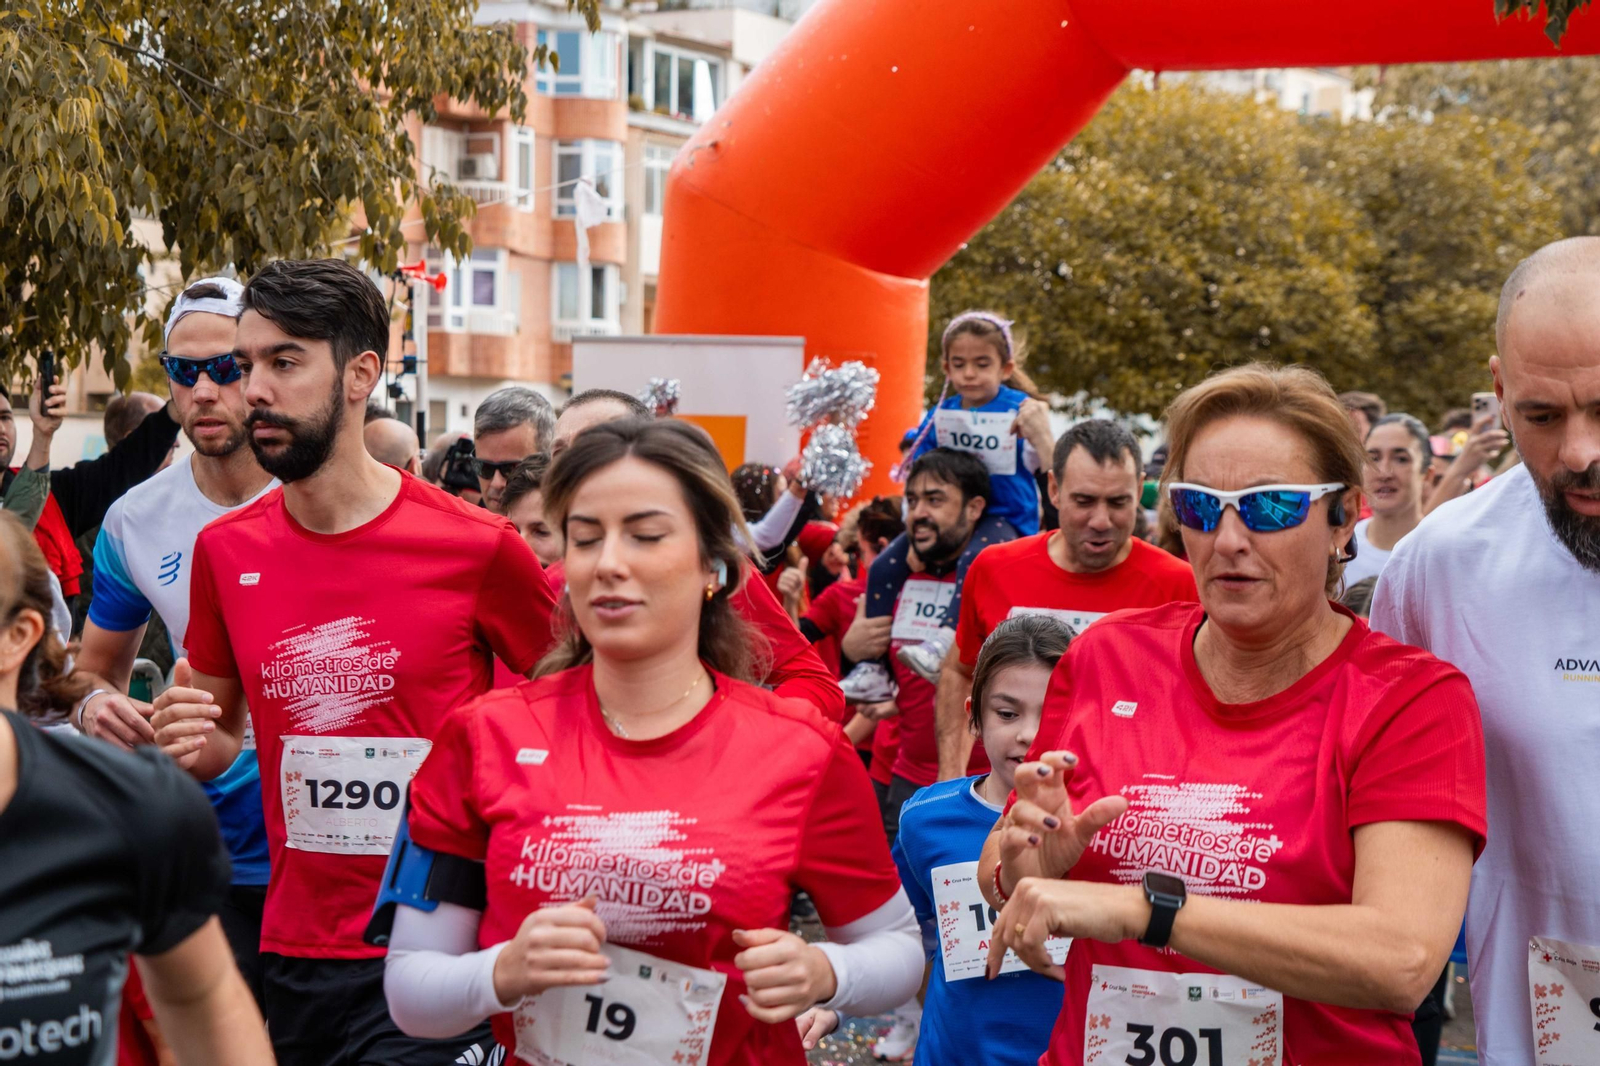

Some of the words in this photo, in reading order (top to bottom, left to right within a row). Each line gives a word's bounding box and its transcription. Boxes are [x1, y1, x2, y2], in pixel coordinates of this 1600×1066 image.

[950, 432, 999, 450] 1020
[915, 602, 949, 619] 102
[261, 656, 362, 679] kilómetros
[367, 653, 395, 670] de
[264, 674, 395, 699] HUMANIDAD
[305, 779, 400, 810] 1290
[325, 817, 378, 828] ALBERTO
[520, 835, 670, 882] kilómetros
[676, 862, 716, 889] de
[1092, 831, 1267, 890] HUMANIDAD
[1236, 836, 1272, 863] de
[515, 864, 712, 915] HUMANIDAD
[584, 993, 636, 1042] 19
[1124, 1022, 1224, 1066] 301
